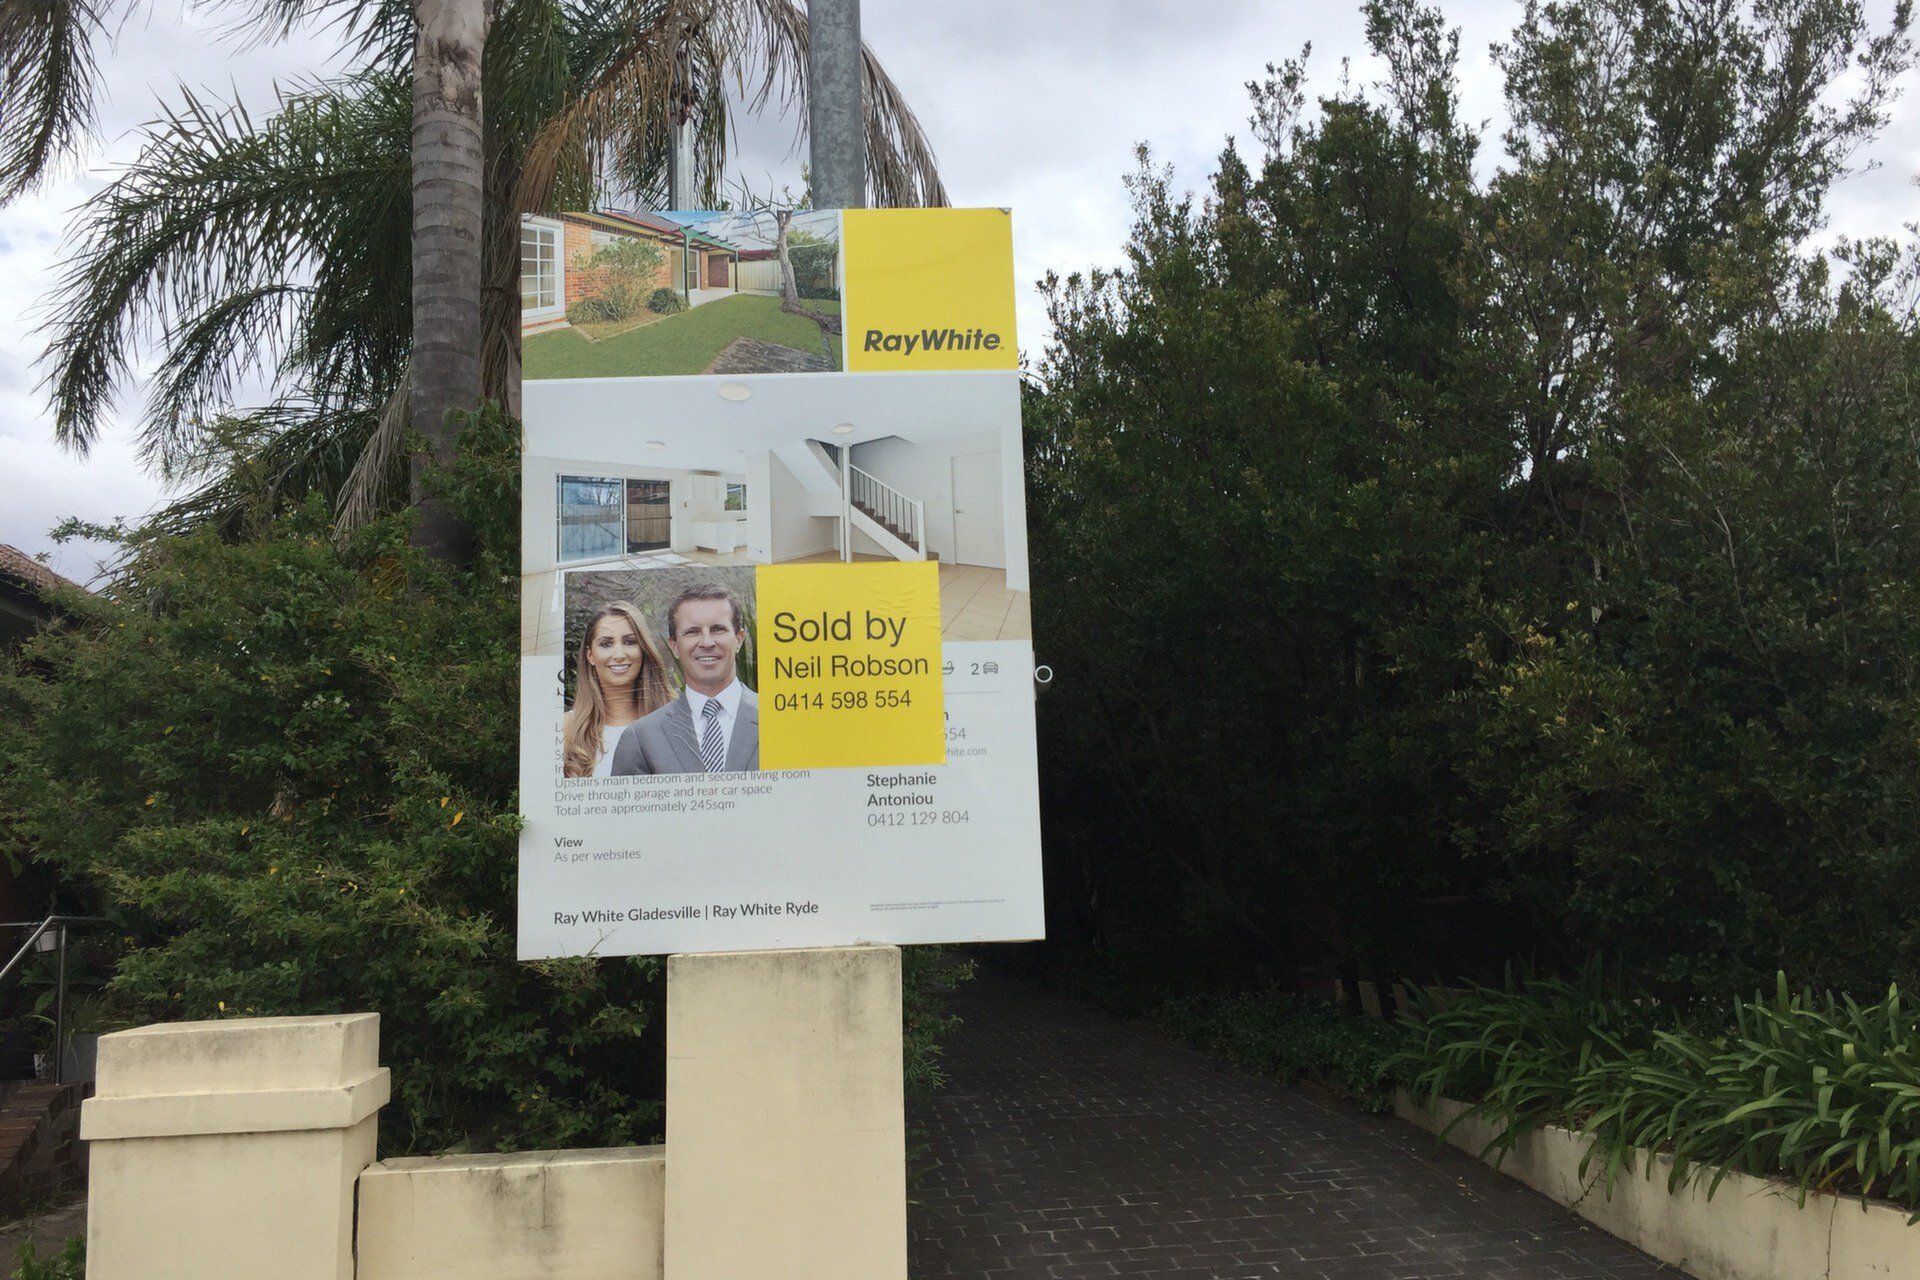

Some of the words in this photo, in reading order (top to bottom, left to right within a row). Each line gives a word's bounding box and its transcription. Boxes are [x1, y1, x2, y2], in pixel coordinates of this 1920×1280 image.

[773, 611, 851, 643] Sold
[866, 610, 907, 647] by
[775, 656, 821, 679] Neil
[831, 654, 928, 677] Robson
[970, 662, 980, 676] 2
[774, 692, 824, 711] 0414
[831, 690, 868, 709] 598
[875, 689, 912, 708] 554
[554, 777, 600, 789] Upstairs
[602, 776, 629, 787] main
[632, 774, 682, 785] bedroom
[685, 772, 705, 782] and
[708, 770, 747, 782] second
[750, 770, 779, 781] living
[782, 769, 811, 779] room
[867, 772, 937, 789] Stephanie
[554, 790, 585, 802] Drive
[588, 788, 631, 801] through
[634, 788, 671, 800] garage
[673, 786, 694, 797] and
[697, 786, 719, 796] rear
[721, 785, 739, 795] car
[741, 784, 773, 796] space
[867, 792, 934, 807] Antoniou
[554, 804, 581, 816] Total
[584, 806, 608, 815] area
[610, 801, 687, 816] approximately
[690, 799, 735, 812] 245sqm
[867, 812, 905, 827] 0412
[911, 811, 937, 825] 129
[942, 810, 970, 824] 804
[554, 836, 584, 848] View
[553, 851, 569, 862] As
[571, 852, 591, 864] per
[593, 849, 642, 861] websites
[554, 911, 579, 926] Ray
[582, 909, 624, 923] White
[628, 906, 701, 921] Gladesville
[712, 904, 738, 919] Ray
[740, 902, 782, 917] White
[785, 901, 820, 916] Ryde
